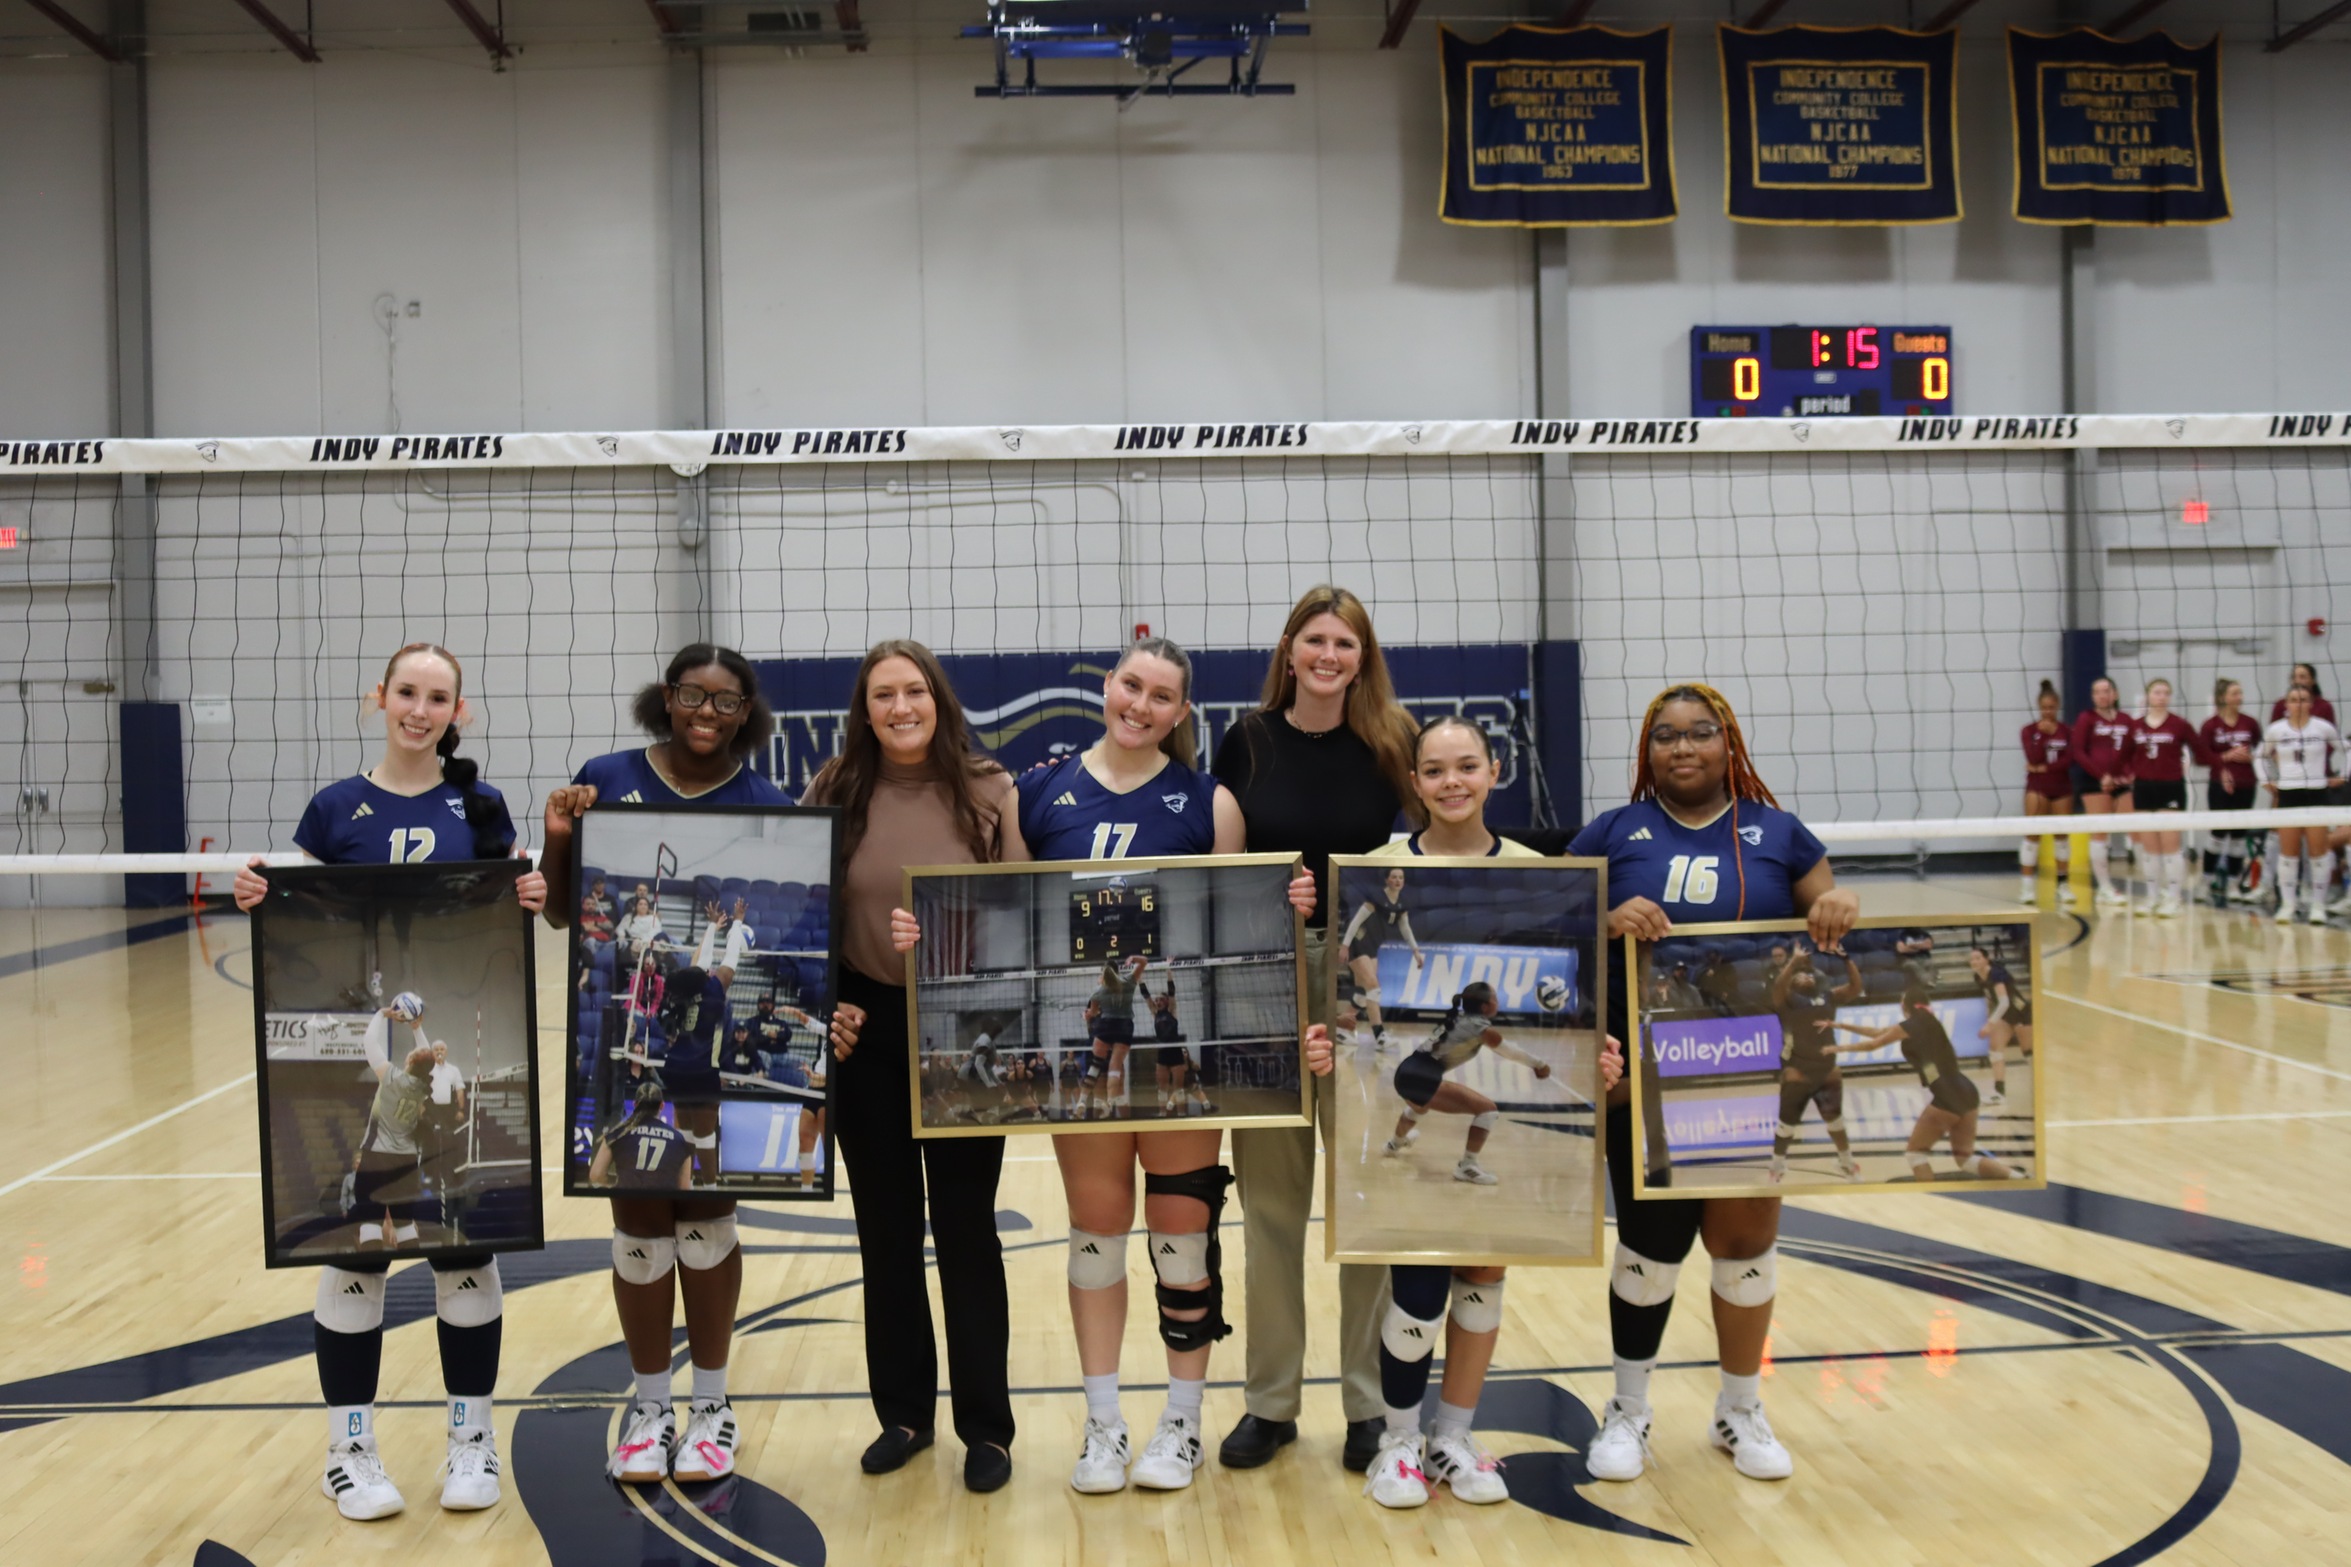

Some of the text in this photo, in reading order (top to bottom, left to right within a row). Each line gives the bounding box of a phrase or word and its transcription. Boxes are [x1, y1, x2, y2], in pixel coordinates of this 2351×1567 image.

[1496, 69, 1612, 88] INDEPENDENCE
[1780, 69, 1897, 89] INDEPENDENCE
[2066, 71, 2174, 91] INDEPENDENCE
[1489, 91, 1620, 107] COMMUNITY COLLEGE
[1773, 91, 1905, 106] COMMUNITY COLLEGE
[2060, 92, 2125, 108] COMMUNITY
[1515, 106, 1596, 120] BASKETBALL
[1800, 106, 1880, 120] BASKETBALL
[2085, 109, 2158, 123] BASKETBALL
[1526, 123, 1586, 142] NJCAA
[1810, 122, 1871, 141] NJCAA
[2095, 125, 2151, 144] NJCAA
[1476, 145, 1641, 166] NATIONAL CHAMPIONS
[1760, 144, 1923, 165] NATIONAL CHAMPIONS
[2047, 145, 2115, 166] NATIONAL
[1829, 165, 1859, 178] 1977
[1708, 333, 1751, 352] Home
[1812, 328, 1879, 369] 1:15
[1893, 332, 1947, 353] Guests
[1734, 357, 1760, 401] 0
[1922, 357, 1949, 400] 0
[1801, 395, 1851, 415] period
[1511, 421, 1699, 445] INDY PIRATES
[1898, 417, 2078, 441] INDY PIRATES
[2269, 415, 2332, 437] INDY
[711, 430, 906, 456] INDY PIRATES
[1115, 424, 1307, 450] INDY PIRATES
[0, 441, 104, 464] PIRATES
[310, 436, 503, 461] INDY PIRATES
[388, 827, 436, 864] 12
[1090, 822, 1138, 859] 17
[1663, 855, 1719, 905] 16
[1081, 901, 1091, 917] 9
[1141, 895, 1154, 912] 16
[1076, 937, 1084, 950] 0
[1110, 935, 1118, 947] 2
[1397, 954, 1540, 1008] INDY
[1652, 1033, 1769, 1064] Volleyball
[631, 1126, 675, 1140] PIRATES
[635, 1137, 667, 1171] 17
